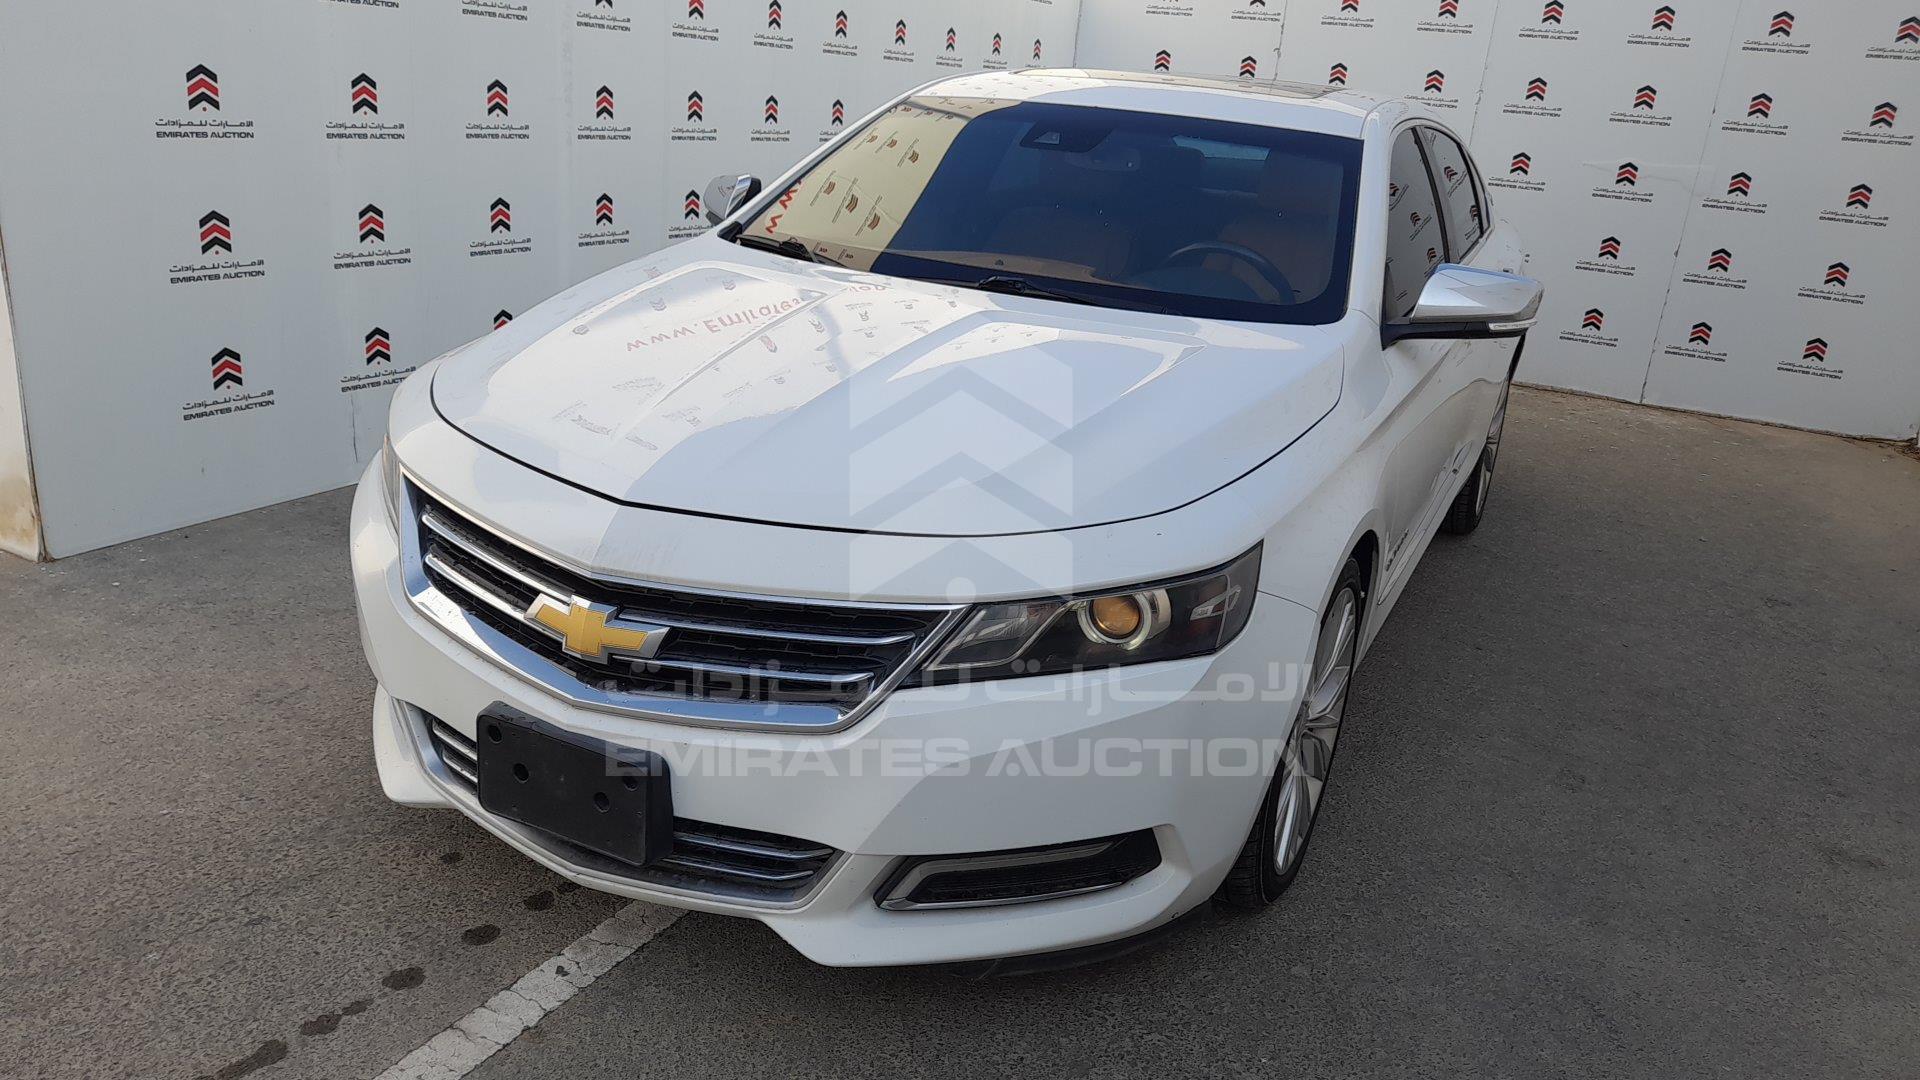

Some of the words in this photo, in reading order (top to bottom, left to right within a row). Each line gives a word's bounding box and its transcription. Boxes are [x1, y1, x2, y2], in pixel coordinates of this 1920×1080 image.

[461, 8, 498, 18] EMIRATES
[497, 12, 528, 21] AUCTION
[576, 20, 606, 30] EMIRATES
[605, 24, 631, 32] AUCTION
[671, 31, 698, 40] EMIRATES
[696, 34, 719, 42] AUCTION
[1502, 108, 1533, 116] EMIRATES
[1608, 117, 1641, 125] EMIRATES
[155, 131, 209, 139] EMIRATES
[210, 131, 255, 139] AUCTION
[325, 132, 369, 140] EMIRATES
[465, 132, 500, 140] EMIRATES
[1841, 136, 1878, 144] EMIRATES
[1517, 185, 1545, 193] AUCTION
[1591, 192, 1623, 200] EMIRATES
[1701, 203, 1735, 211] EMIRATES
[1818, 215, 1854, 224] EMIRATES
[1854, 219, 1887, 227] AUCTION
[578, 239, 606, 248] EMIRATES
[605, 237, 630, 245] AUCTION
[469, 248, 503, 257] EMIRATES
[503, 246, 532, 254] AUCTION
[333, 260, 375, 270] EMIRATES
[375, 257, 412, 266] AUCTION
[169, 273, 221, 284] EMIRATES
[222, 270, 265, 280] AUCTION
[1574, 265, 1606, 273] EMIRATES
[1606, 269, 1634, 277] AUCTION
[1682, 277, 1716, 286] EMIRATES
[1715, 282, 1746, 290] AUCTION
[1797, 292, 1832, 301] EMIRATES
[1831, 297, 1864, 305] AUCTION
[1558, 335, 1590, 344] EMIRATES
[1589, 340, 1617, 348] AUCTION
[1664, 350, 1696, 359] EMIRATES
[1696, 354, 1726, 363] AUCTION
[1776, 366, 1811, 375] EMIRATES
[1810, 371, 1842, 380] AUCTION
[341, 381, 382, 393] EMIRATES
[382, 377, 407, 386] AUCT
[183, 406, 233, 421] EMIRATES
[233, 399, 275, 412] AUCTION
